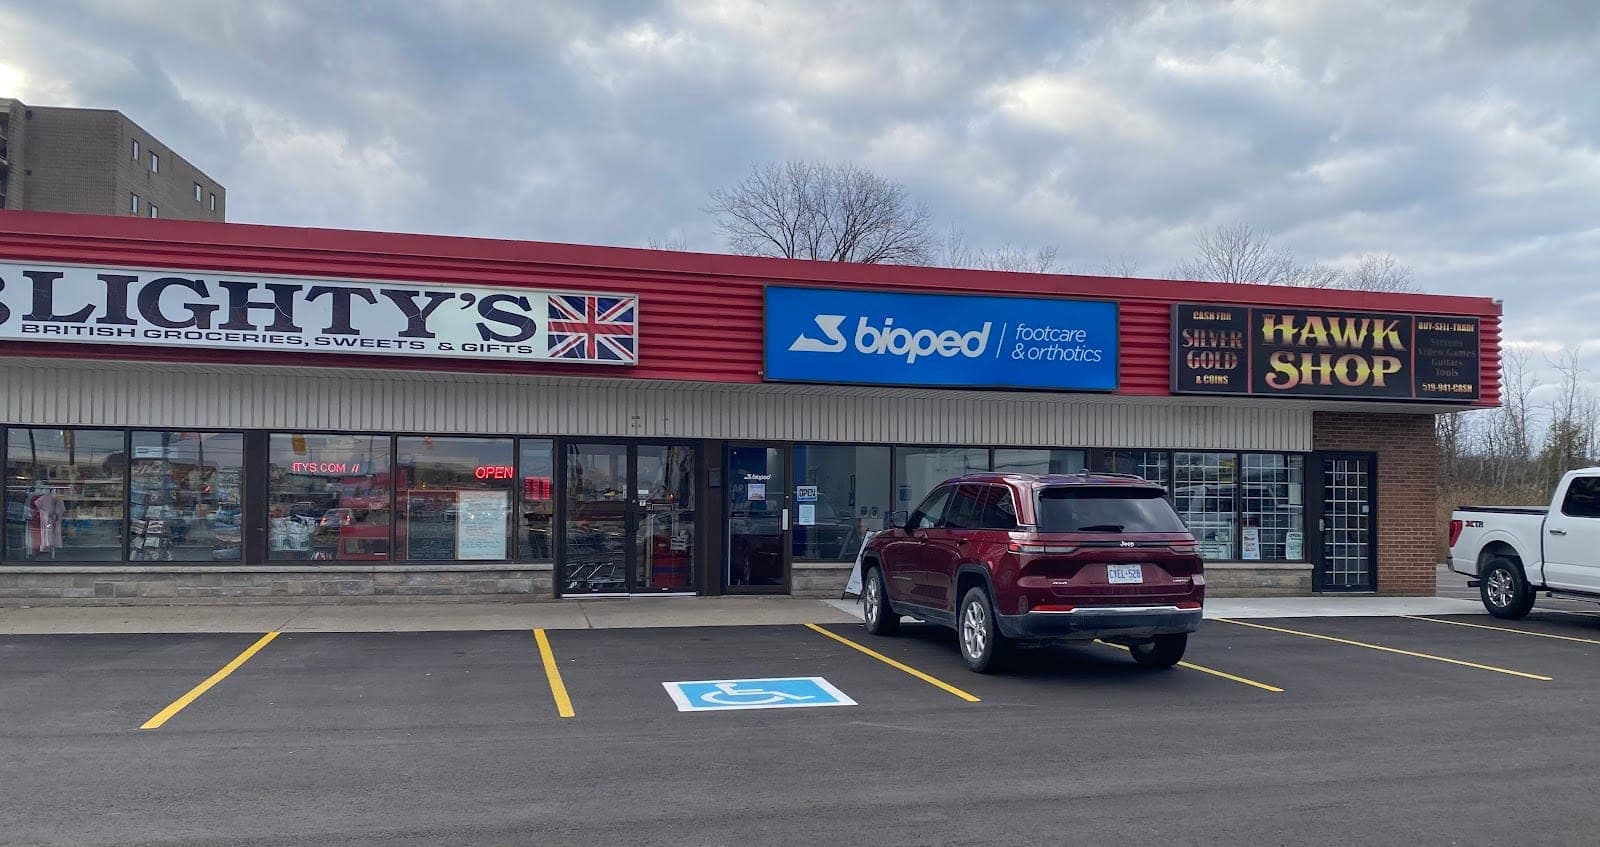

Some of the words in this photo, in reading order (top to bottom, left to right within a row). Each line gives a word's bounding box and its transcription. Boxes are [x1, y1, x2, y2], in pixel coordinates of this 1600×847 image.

[1193, 311, 1215, 320] CASH
[1216, 312, 1232, 321] FOR
[21, 323, 136, 338] BRITISH
[143, 329, 309, 347] GROCERIES,
[314, 337, 425, 350] SWEETS
[438, 342, 455, 351] &
[461, 343, 532, 354] GIFTS
[855, 316, 992, 364] bioped
[1016, 323, 1087, 342] footcare
[1182, 328, 1243, 349] SILVER
[1262, 314, 1406, 351] HAWK
[1011, 343, 1025, 360] &
[1027, 343, 1102, 362] orthotics
[1186, 350, 1238, 370] GOLD
[1418, 347, 1443, 357] Video
[1446, 348, 1477, 358] Games
[1265, 350, 1402, 390] SHOP
[1431, 357, 1463, 367] Guitars
[1203, 374, 1229, 385] COINS
[1434, 367, 1460, 377] Tools
[475, 466, 514, 479] OPEN
[799, 488, 816, 497] OPEN
[1119, 540, 1135, 548] Jeep
